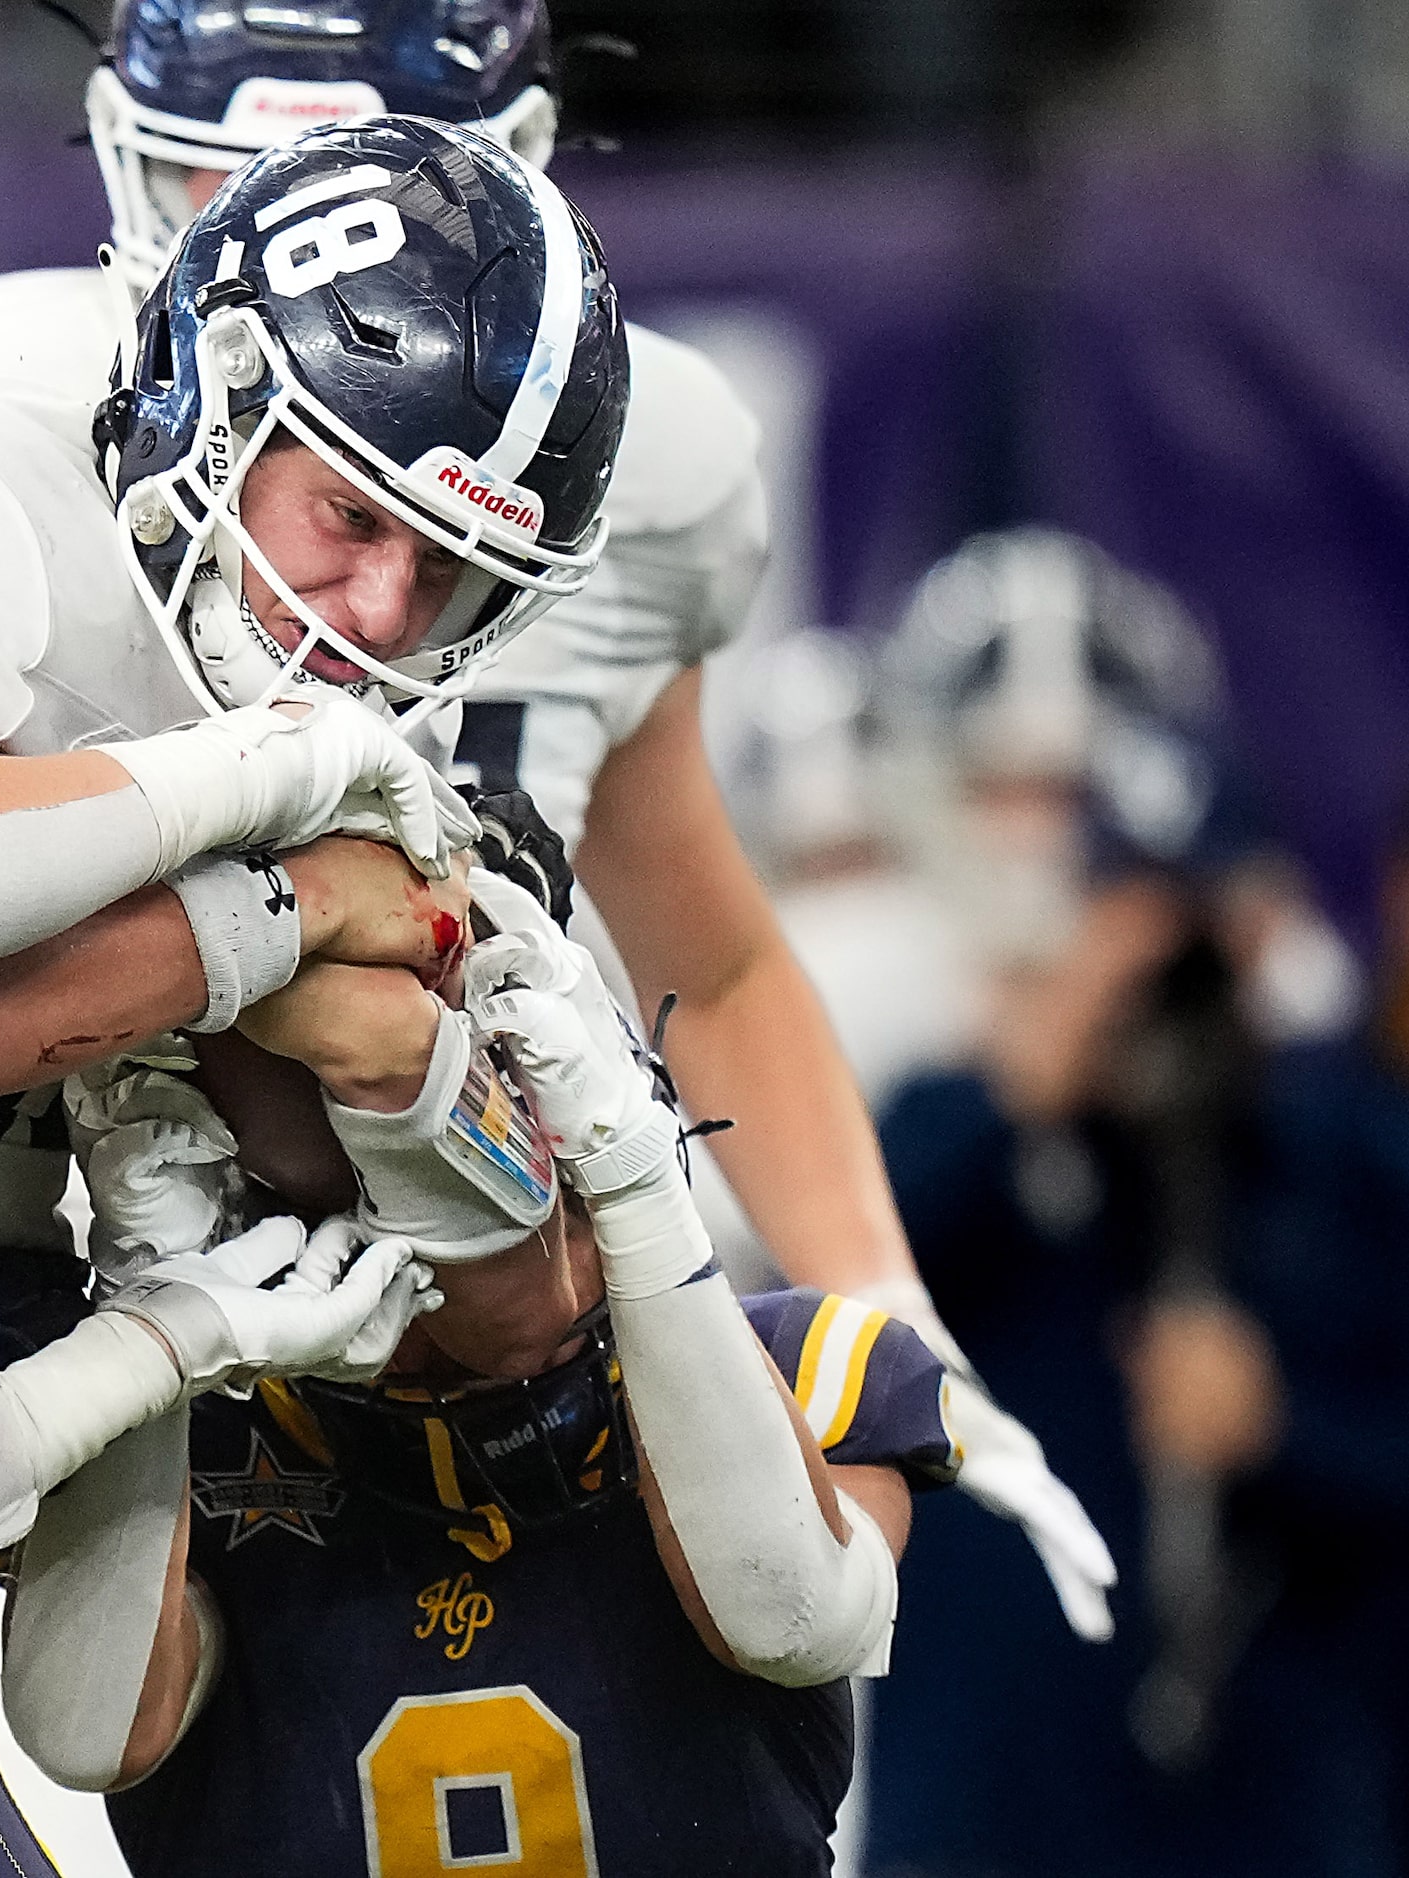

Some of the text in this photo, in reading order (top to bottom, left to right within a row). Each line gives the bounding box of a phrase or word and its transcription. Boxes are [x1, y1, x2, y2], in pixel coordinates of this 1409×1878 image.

[254, 163, 406, 299] 18
[207, 424, 229, 486] SPOR
[437, 464, 535, 529] Riddell
[414, 1572, 496, 1660] HP
